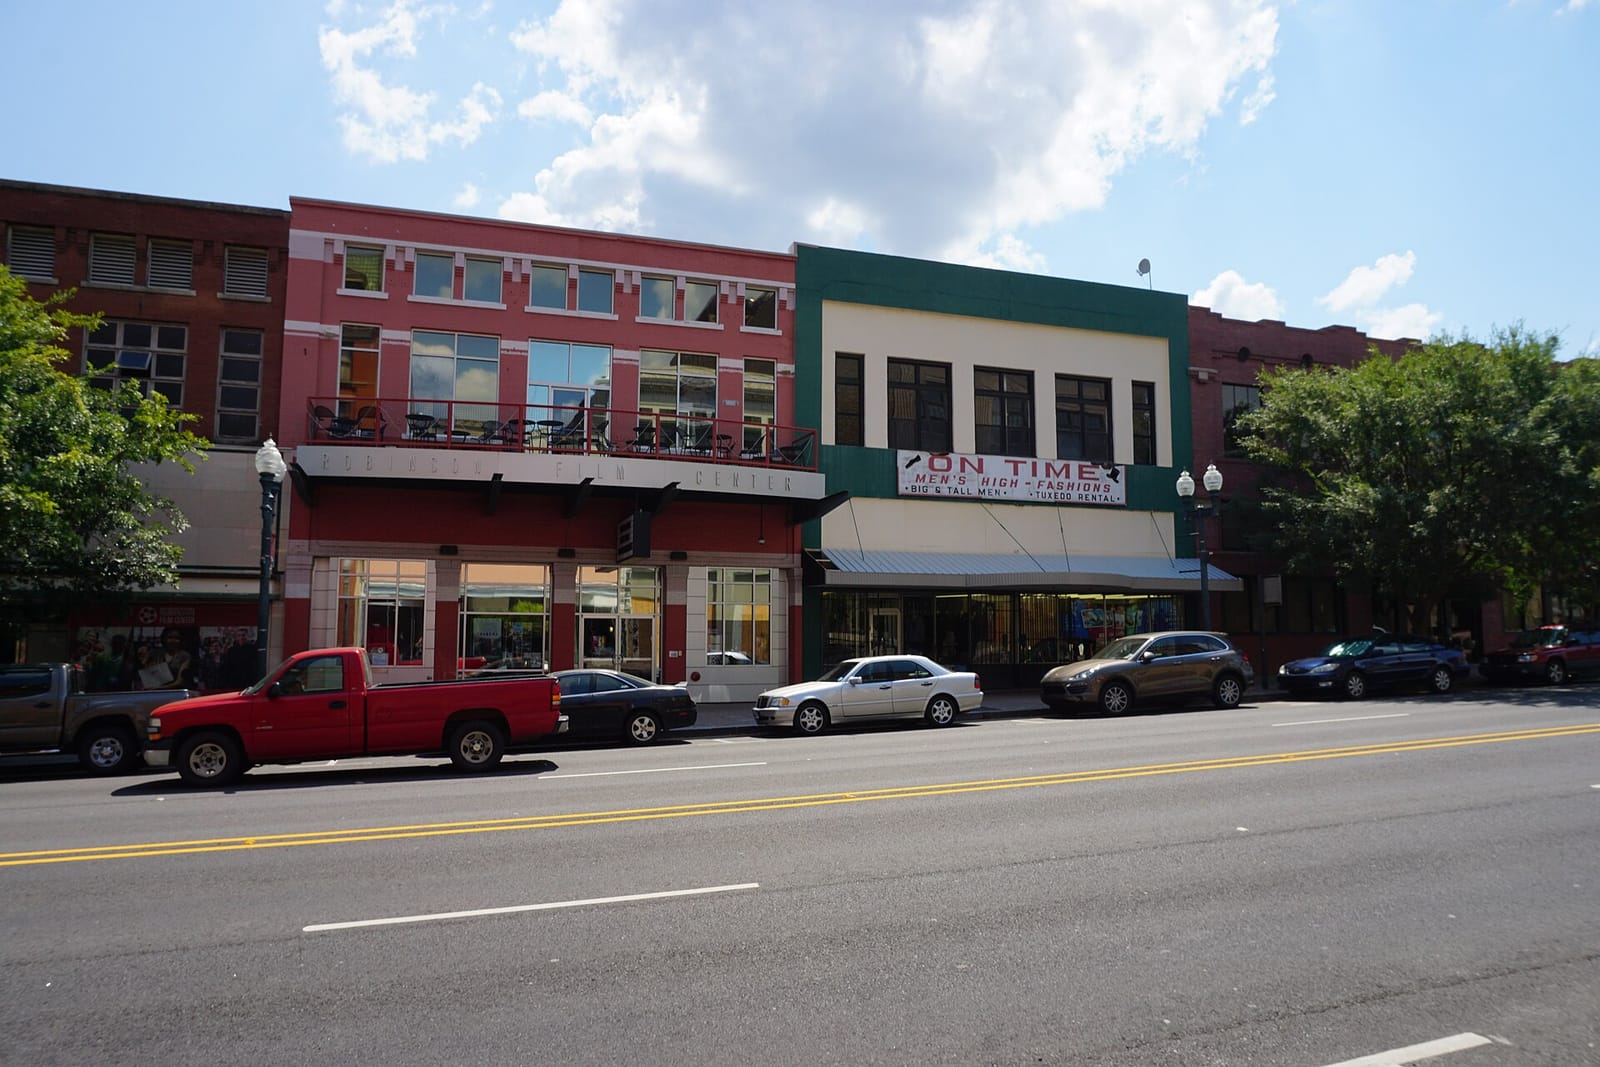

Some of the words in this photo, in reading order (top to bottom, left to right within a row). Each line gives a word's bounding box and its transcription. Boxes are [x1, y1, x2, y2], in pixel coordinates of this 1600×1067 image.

[321, 452, 481, 476] ROBINSON
[556, 462, 625, 480] FILM
[696, 470, 791, 492] CENTER
[928, 454, 984, 474] ON
[1004, 459, 1100, 481] TIME
[911, 485, 928, 493] BIG
[947, 487, 972, 496] TALL
[978, 489, 1001, 497] MEN
[916, 474, 966, 485] MEN'S
[981, 477, 1018, 488] HIGH
[1037, 480, 1111, 493] FASHIONS
[1036, 492, 1072, 501] TUXEDO
[1078, 494, 1115, 503] RENTAL
